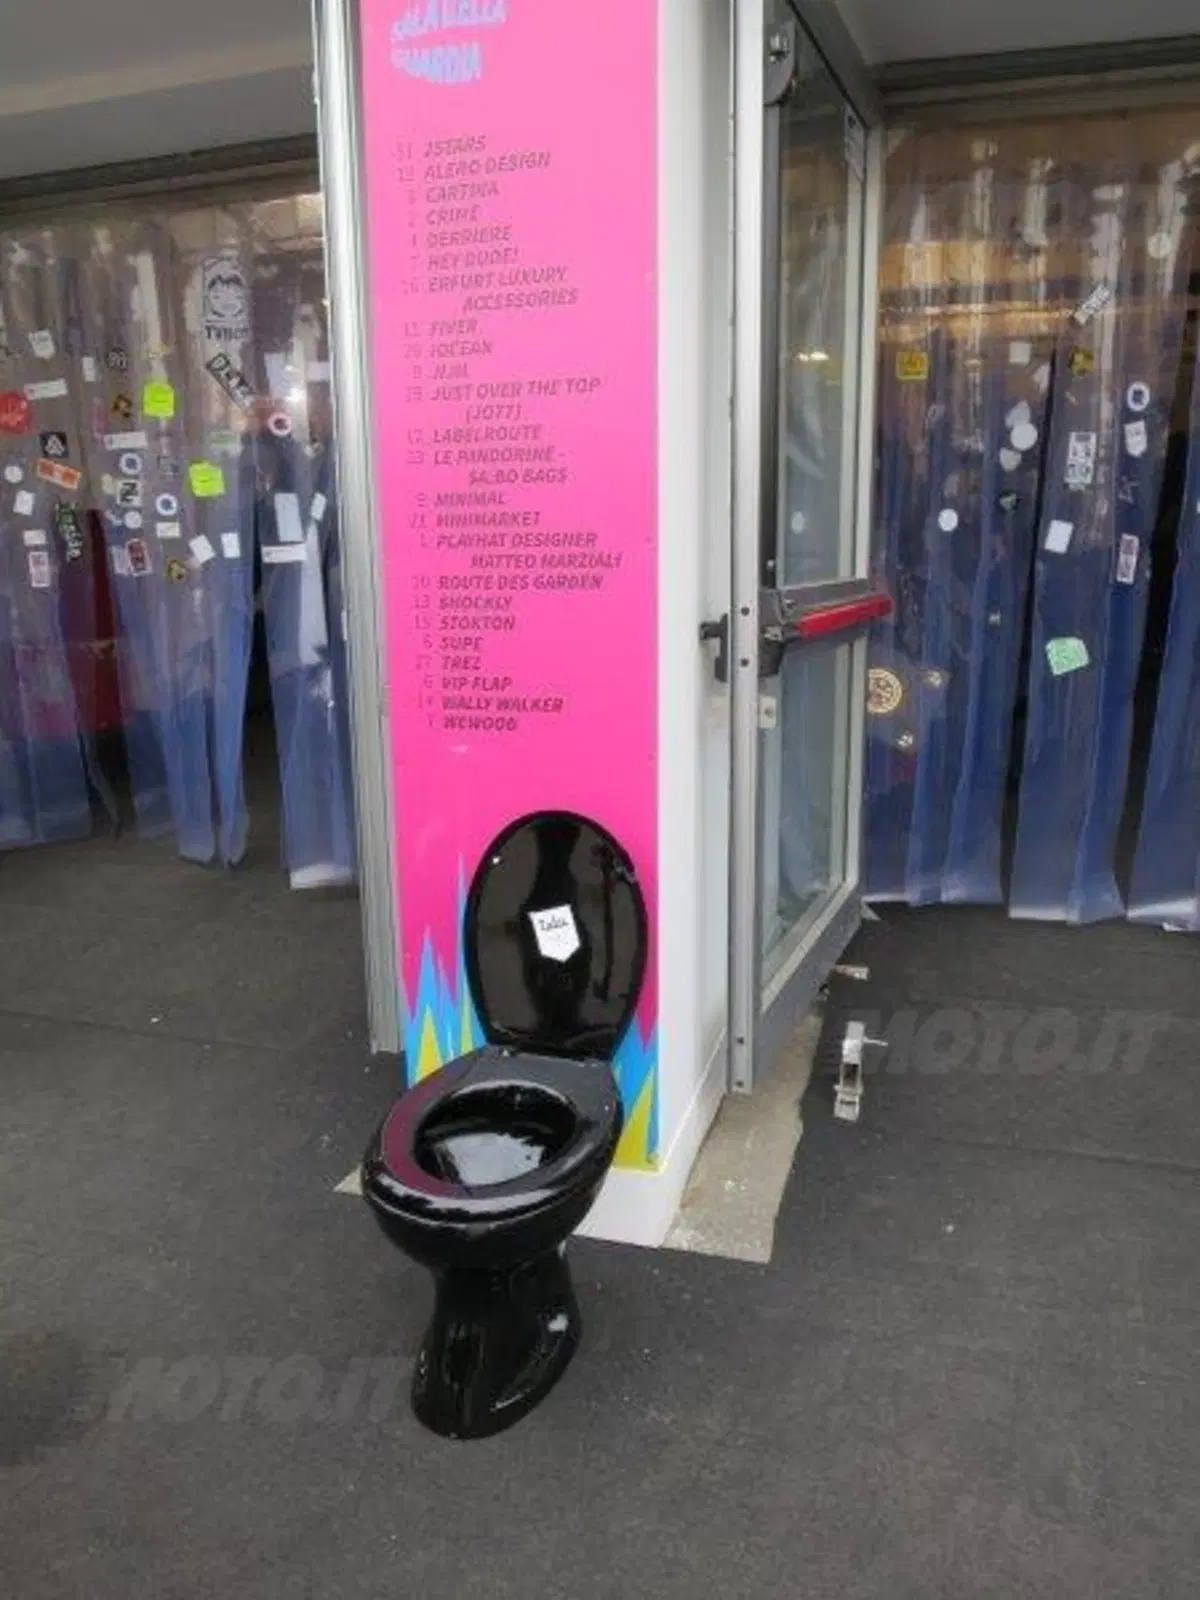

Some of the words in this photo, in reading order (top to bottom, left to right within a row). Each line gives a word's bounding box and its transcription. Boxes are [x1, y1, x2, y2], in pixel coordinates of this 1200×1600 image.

[430, 383, 473, 402] JUST
[564, 376, 602, 395] TOP
[511, 532, 598, 549] DESIGNER
[437, 575, 493, 591] ROUTE
[496, 575, 530, 591] DES
